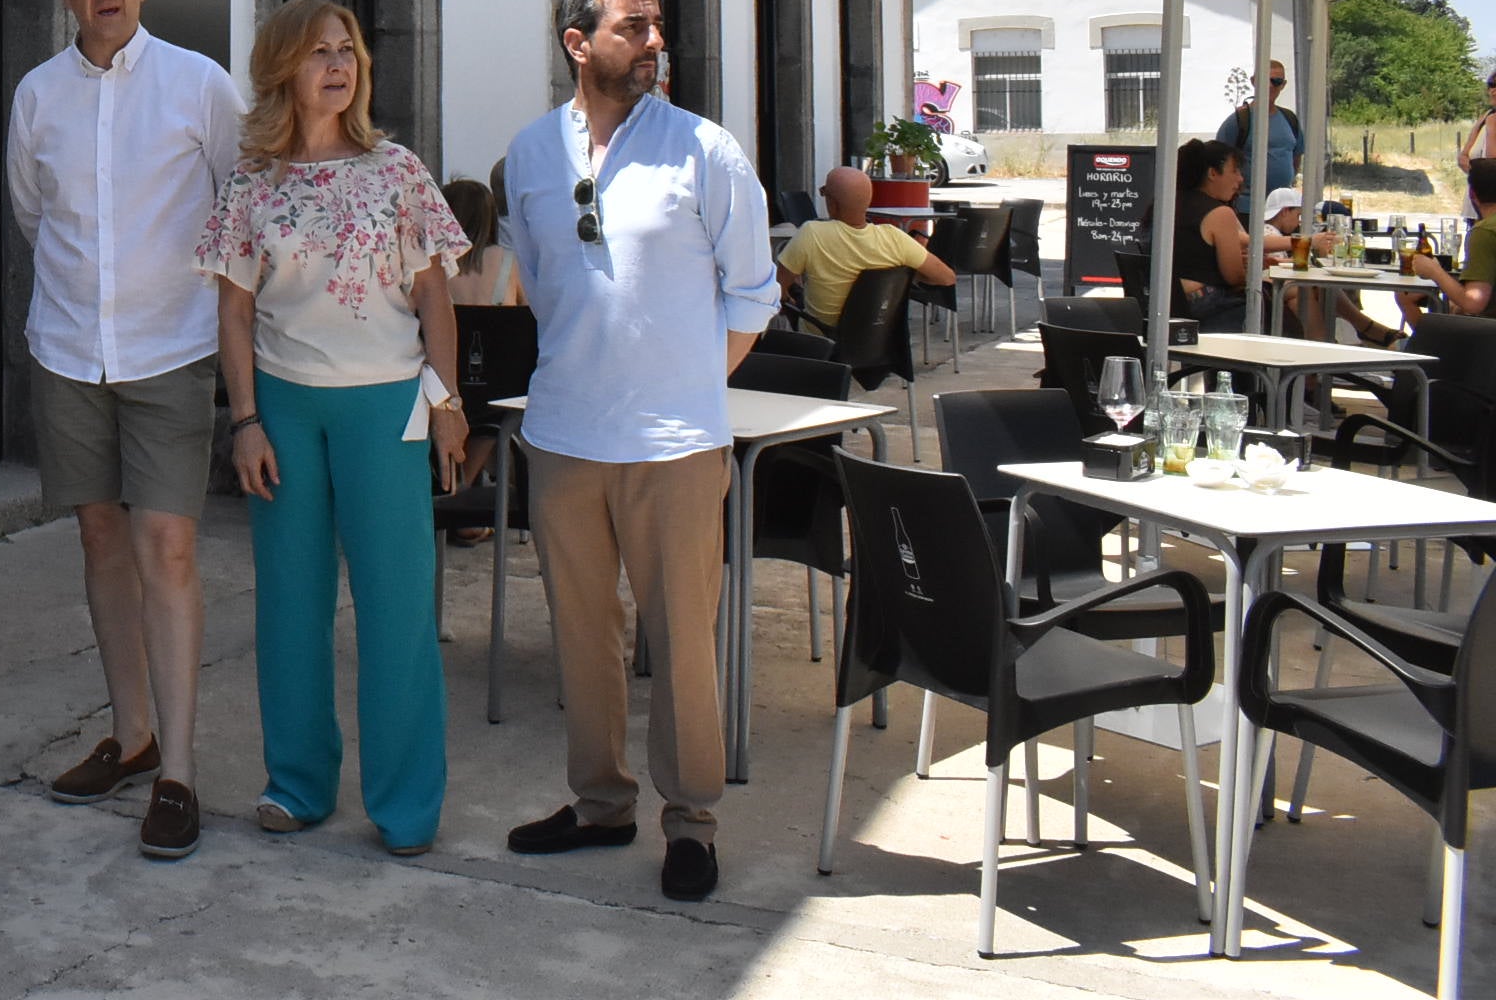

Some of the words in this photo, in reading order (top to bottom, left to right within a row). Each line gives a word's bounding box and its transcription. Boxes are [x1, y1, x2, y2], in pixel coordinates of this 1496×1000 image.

[1086, 172, 1133, 183] HORARIO
[1102, 191, 1108, 201] y
[1110, 187, 1139, 199] martes
